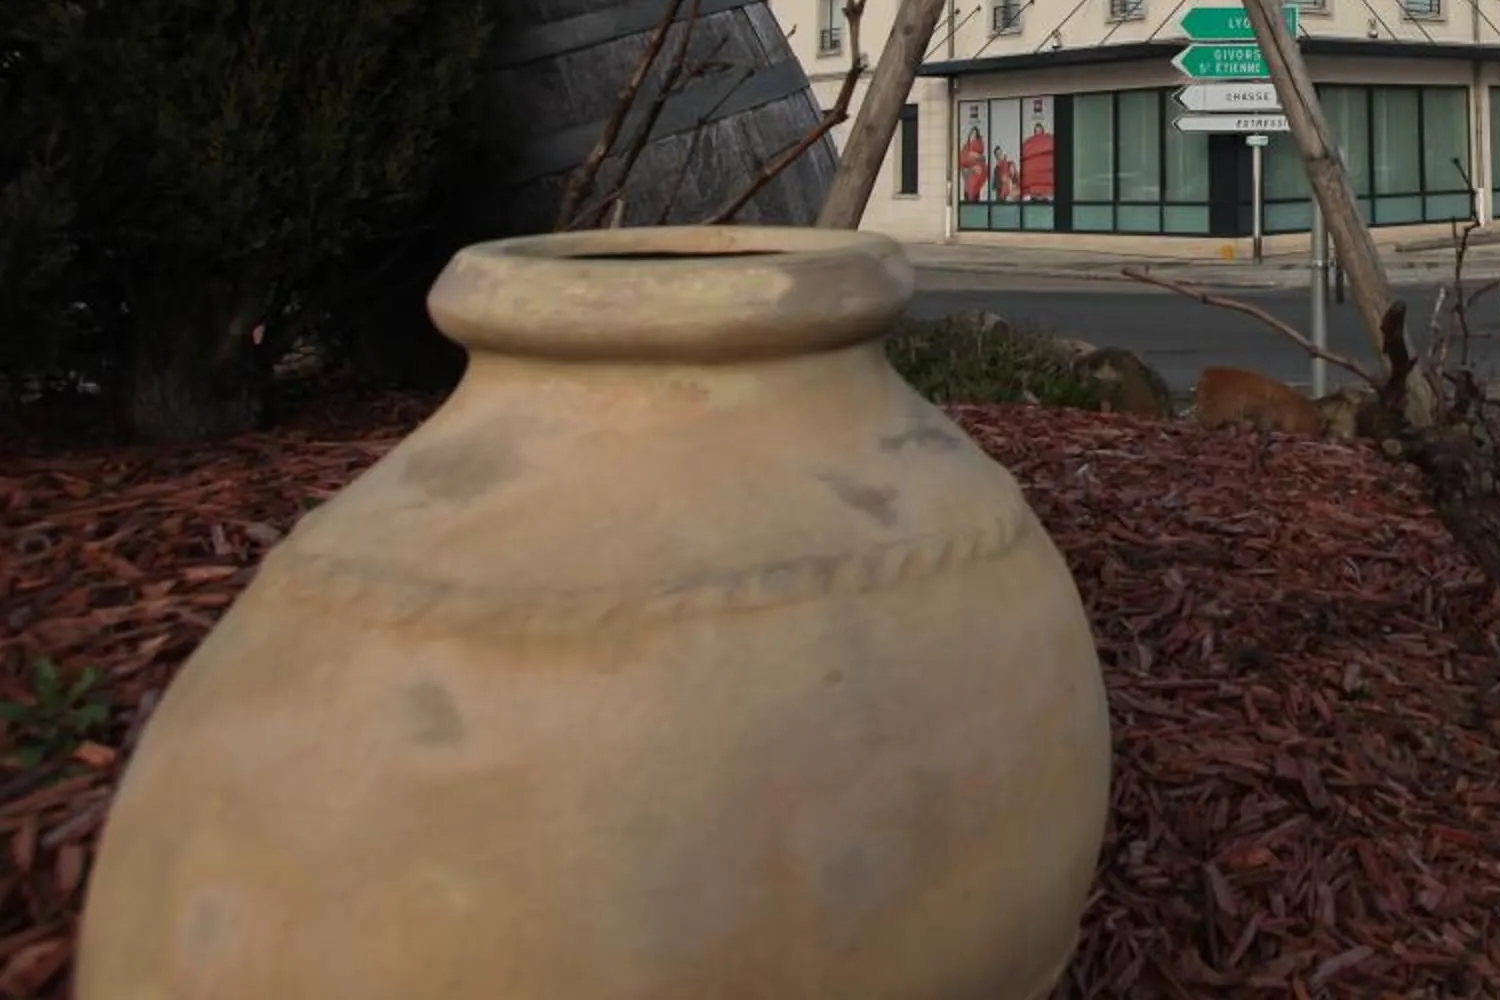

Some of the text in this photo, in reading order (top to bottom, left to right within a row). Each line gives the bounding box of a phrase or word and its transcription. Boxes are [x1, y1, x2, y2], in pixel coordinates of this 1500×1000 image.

[1227, 16, 1251, 29] LYO
[1213, 48, 1262, 61] GIVORS
[1215, 61, 1261, 74] ETIENNE
[1225, 92, 1271, 102] CHASSE
[1235, 118, 1289, 129] ESTRESSI
